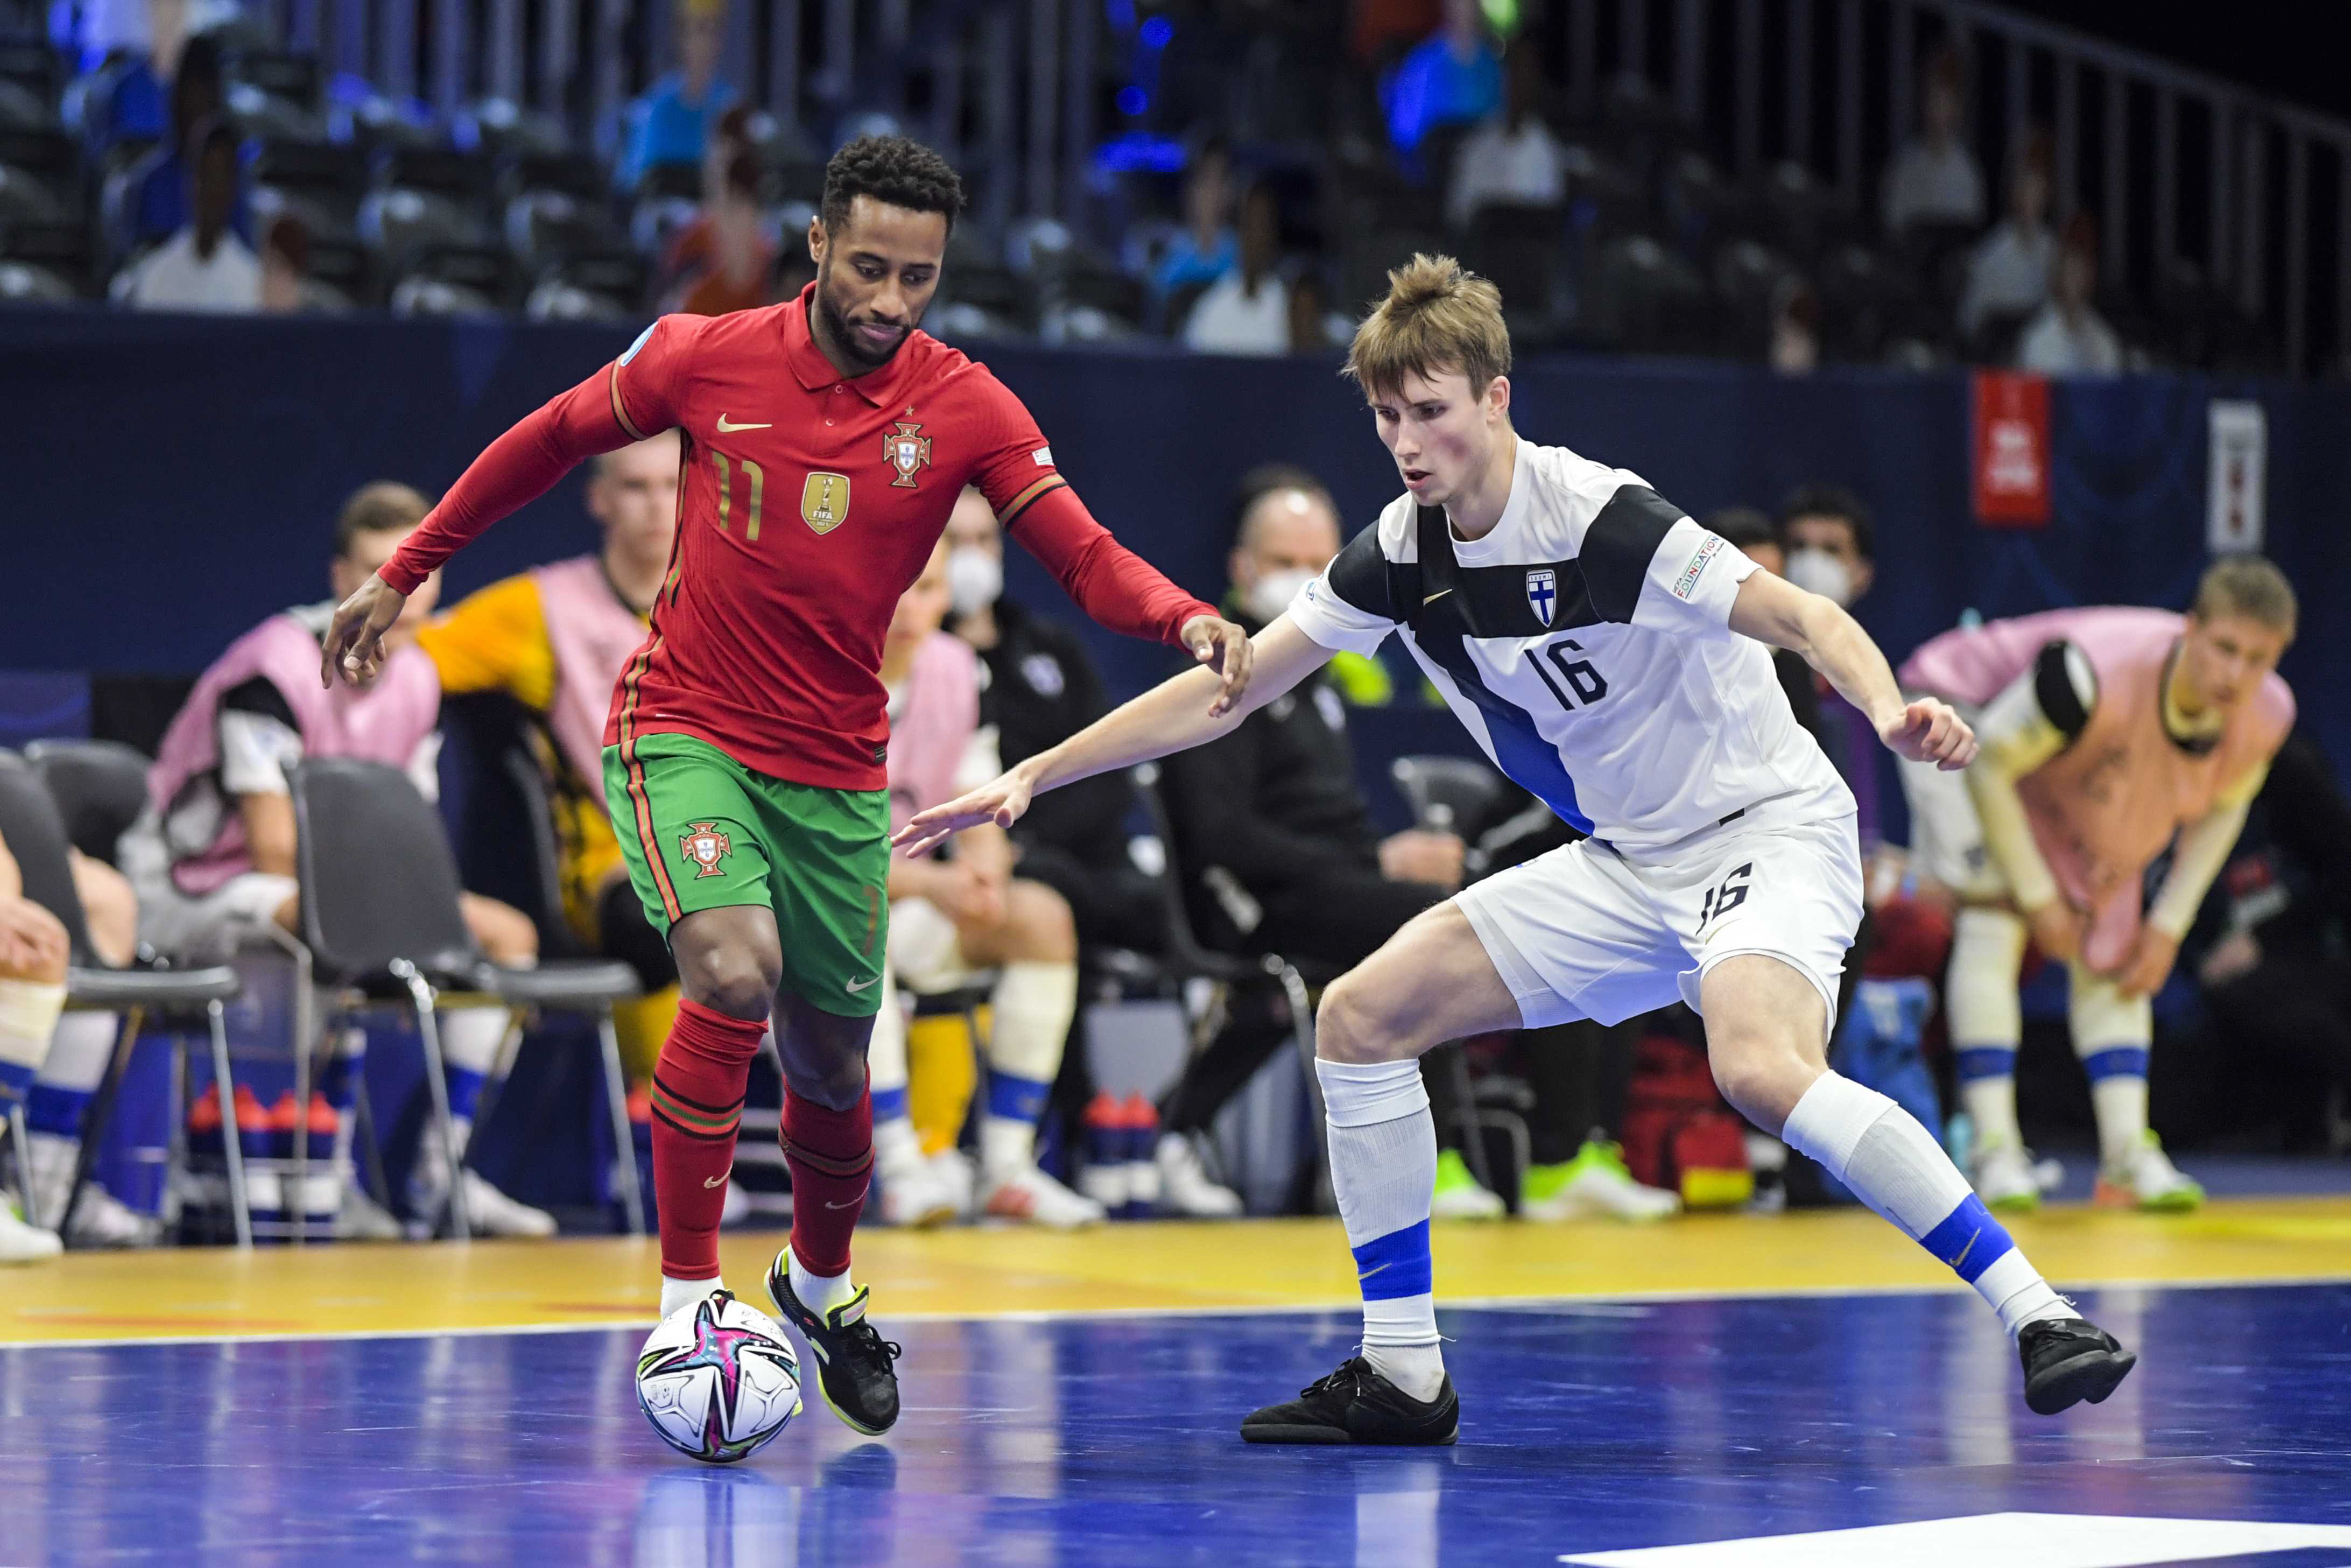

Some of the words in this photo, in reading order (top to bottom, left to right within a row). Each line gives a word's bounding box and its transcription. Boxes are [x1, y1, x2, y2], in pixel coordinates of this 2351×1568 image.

[713, 451, 763, 541] 11
[813, 510, 832, 519] FIFA
[1524, 639, 1608, 711] 16
[1695, 862, 1752, 937] 16
